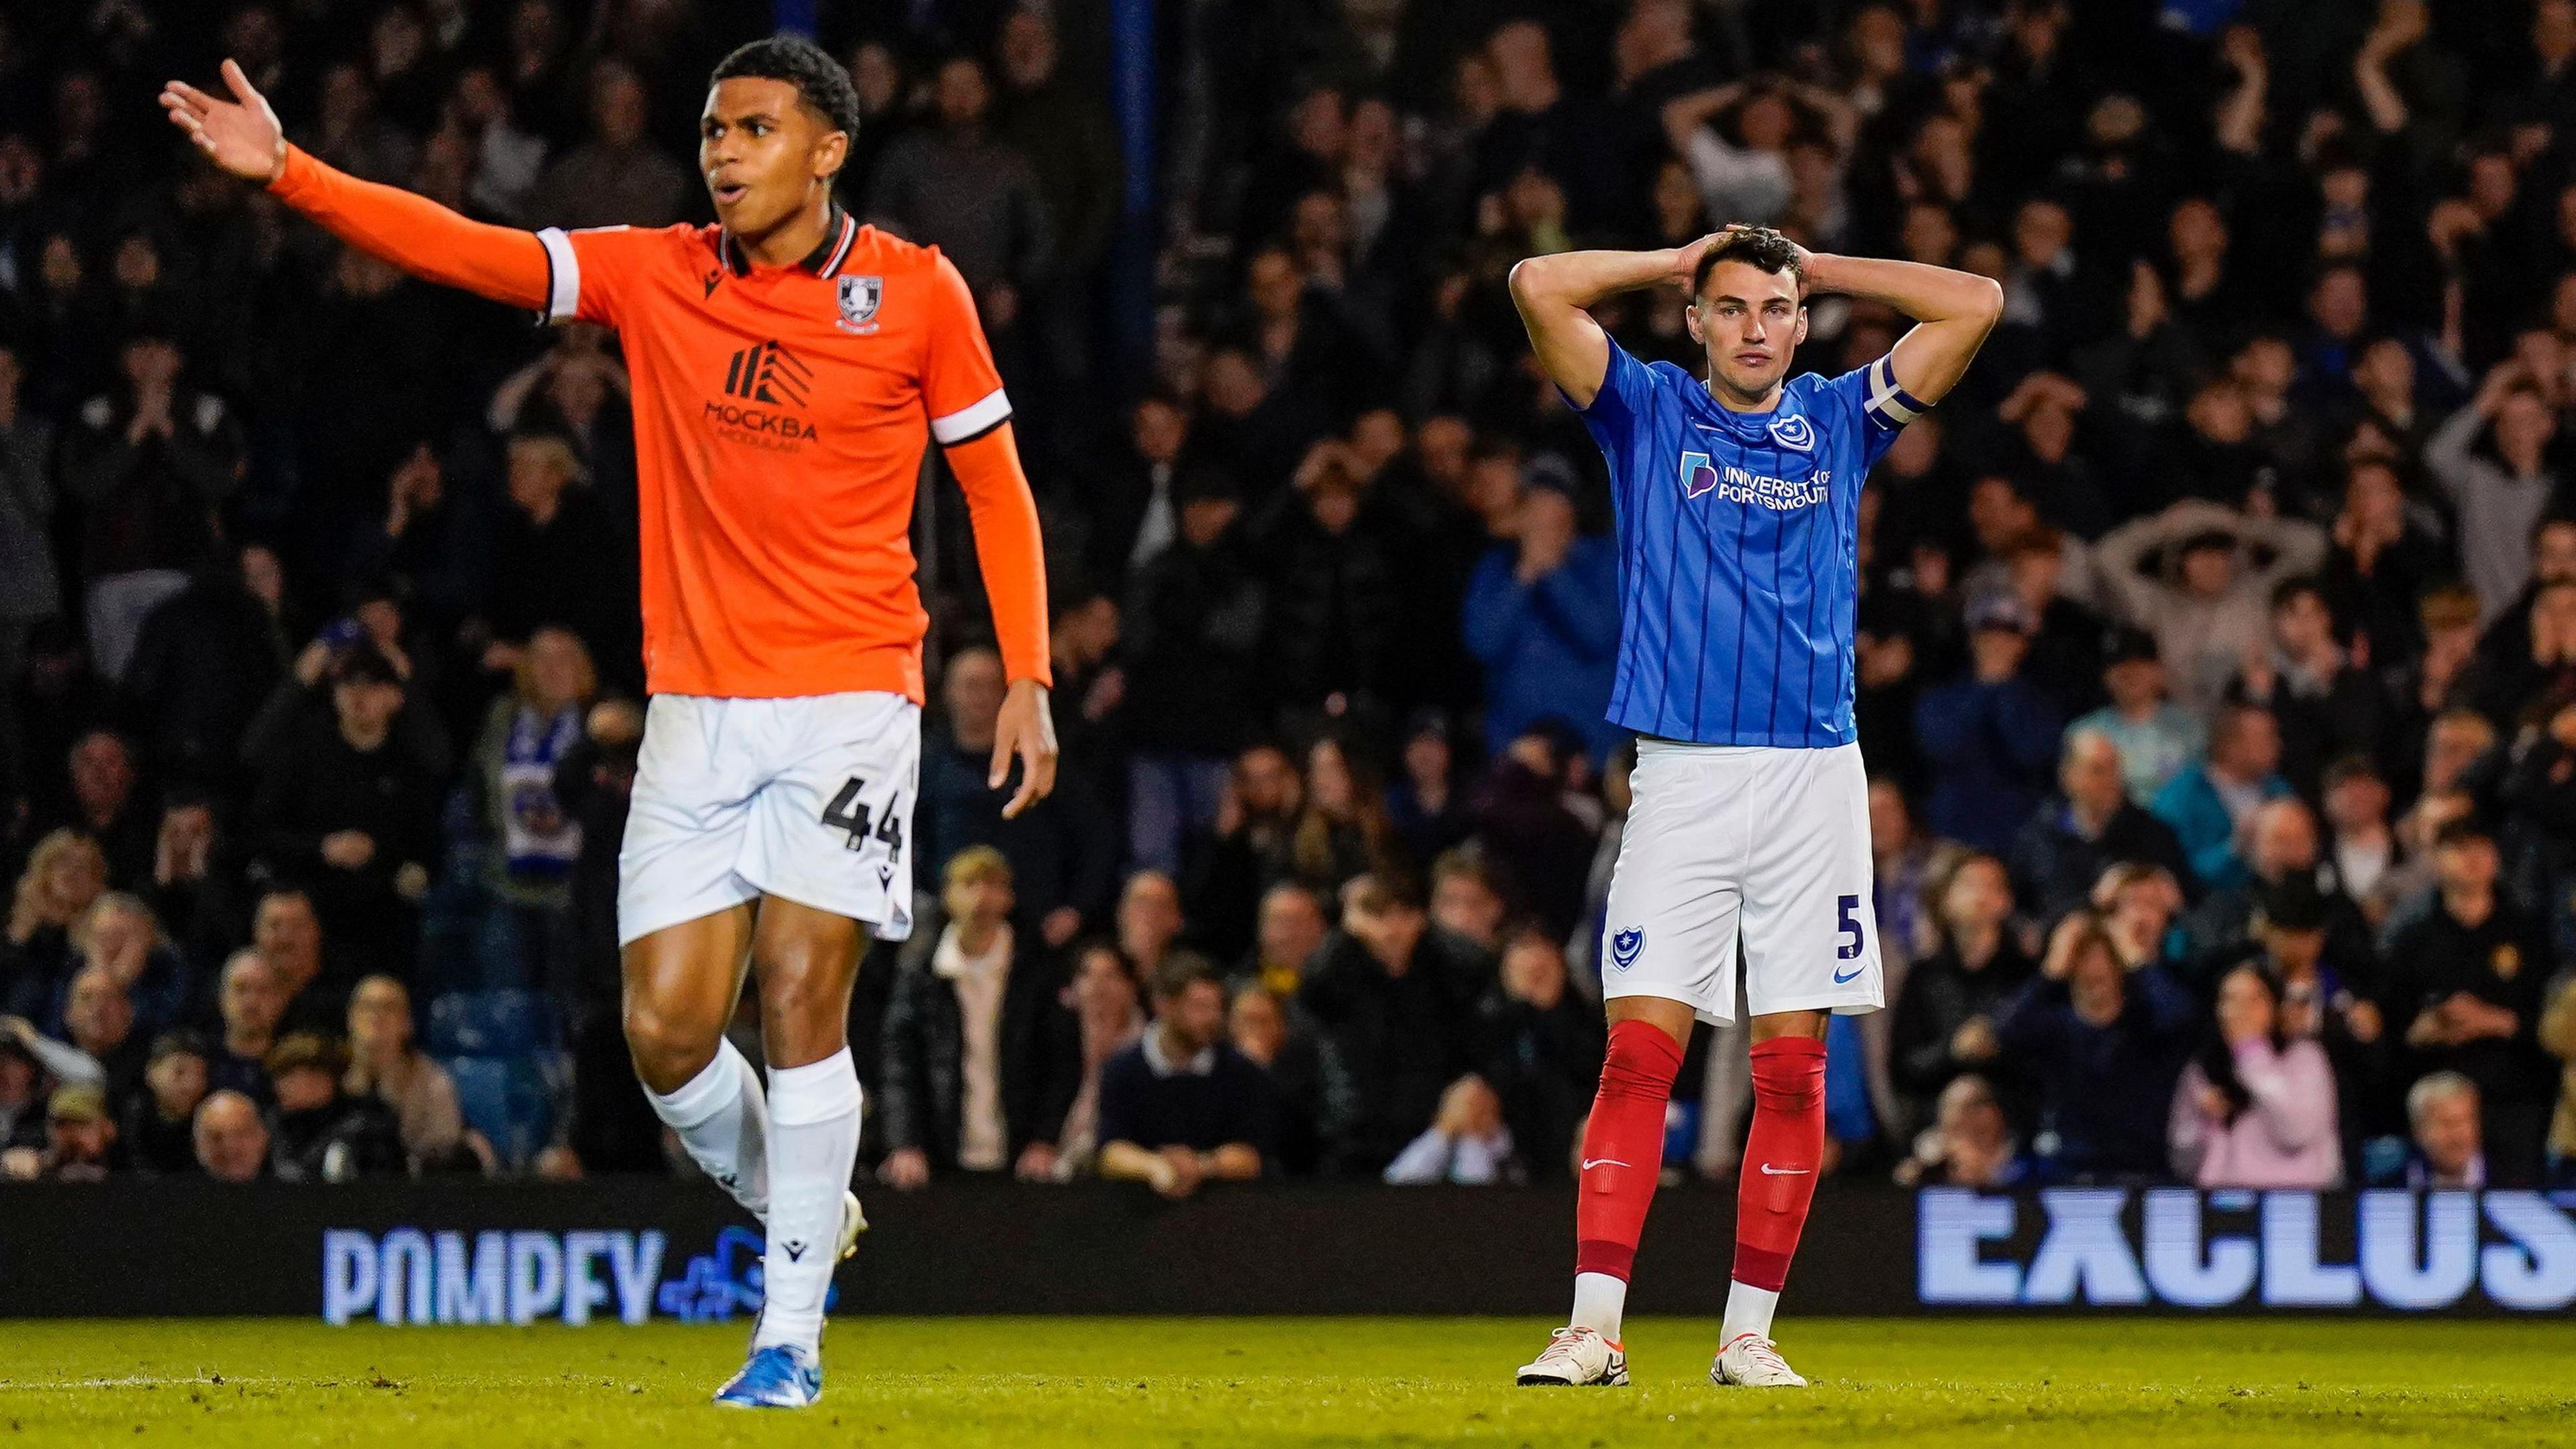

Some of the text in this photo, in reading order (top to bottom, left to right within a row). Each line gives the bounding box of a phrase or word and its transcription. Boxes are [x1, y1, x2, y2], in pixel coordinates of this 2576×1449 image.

[704, 400, 818, 443] MOCKBA
[1718, 482, 1829, 511] PORTSMOUTH
[1719, 466, 1819, 498] UNIVERSITY
[822, 777, 902, 863] 44
[1837, 894, 1864, 959] 5
[1919, 1189, 2576, 1310] EXCLUS
